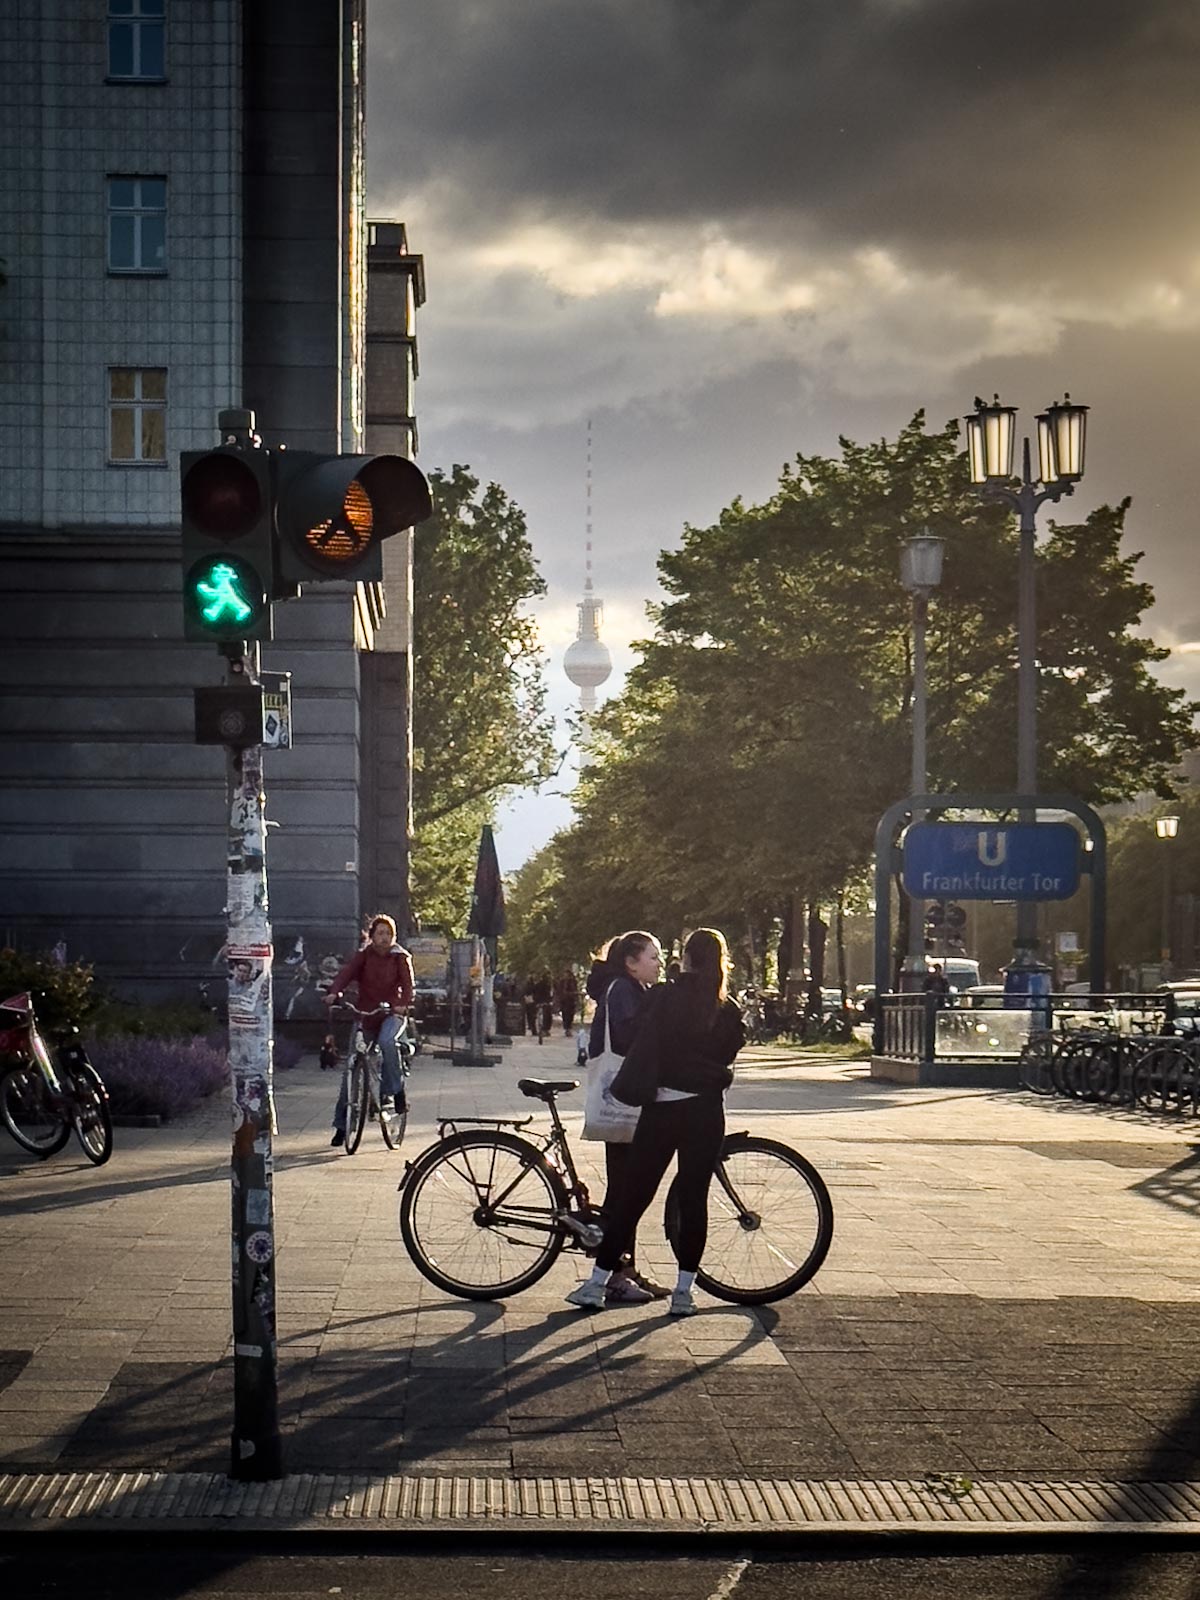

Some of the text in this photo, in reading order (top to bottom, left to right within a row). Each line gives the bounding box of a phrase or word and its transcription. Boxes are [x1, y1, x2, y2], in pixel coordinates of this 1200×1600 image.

[978, 832, 1007, 867] U
[922, 872, 1062, 891] Frankfurter Tor
